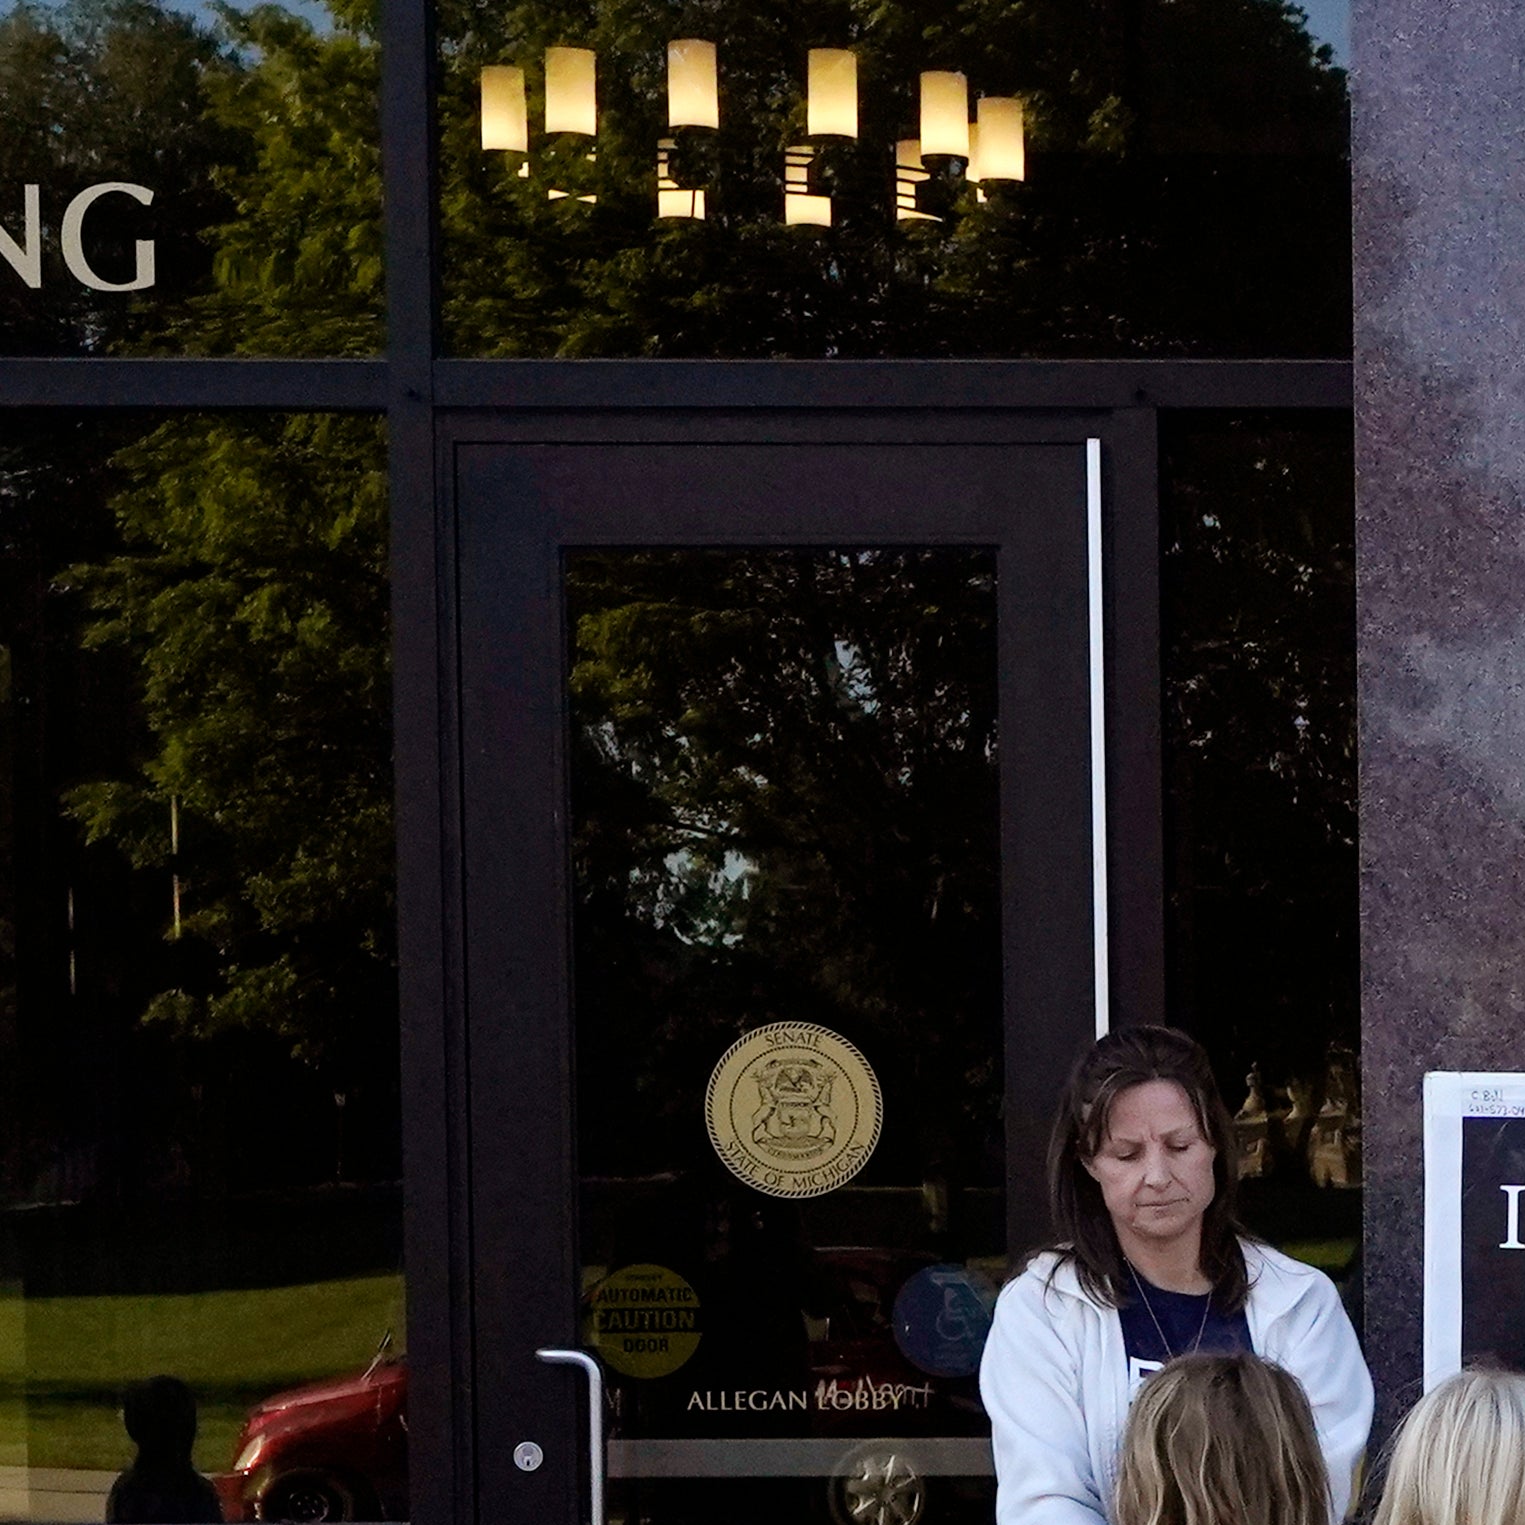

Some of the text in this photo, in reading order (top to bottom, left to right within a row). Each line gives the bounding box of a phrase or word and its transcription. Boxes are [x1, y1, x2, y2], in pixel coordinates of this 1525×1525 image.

[765, 1031, 823, 1048] SENATE
[725, 1140, 867, 1190] STATE OF MICHIGAN
[597, 1287, 693, 1303] AUTOMATIC
[592, 1310, 696, 1330] CAUTION
[623, 1338, 669, 1353] DOOR
[687, 1391, 808, 1411] ALLEGAN
[817, 1391, 903, 1411] LOBBY
